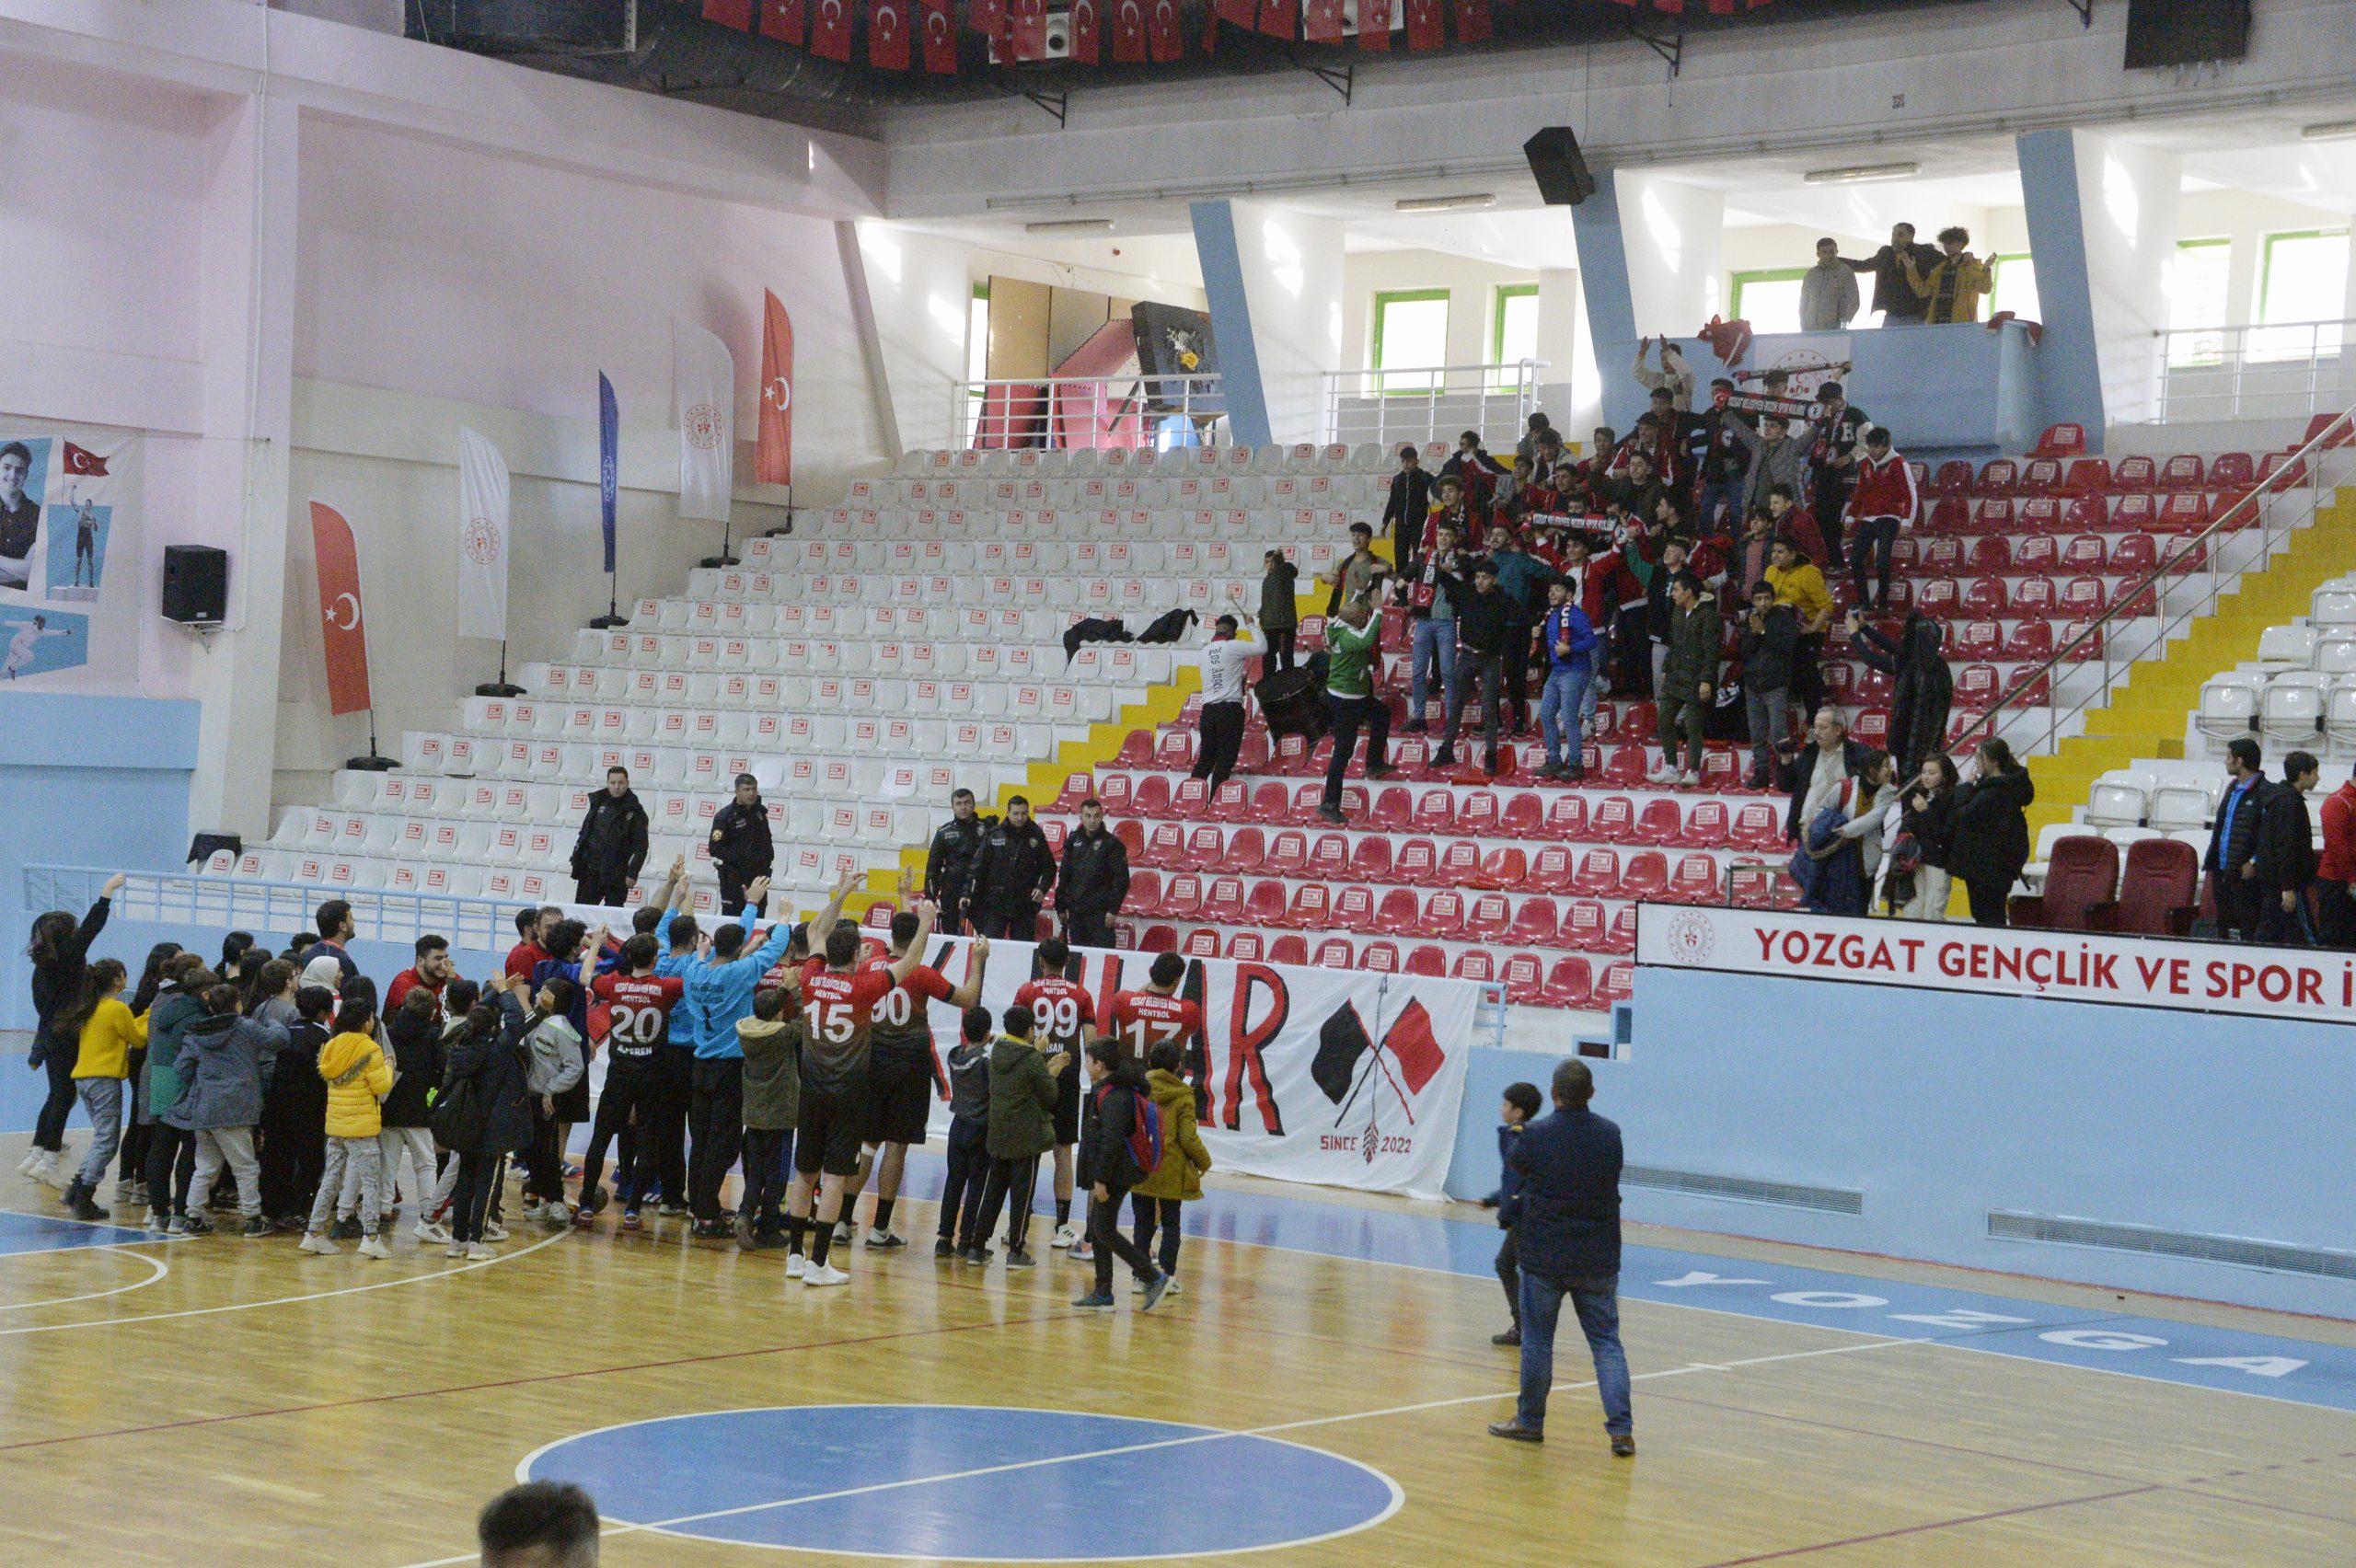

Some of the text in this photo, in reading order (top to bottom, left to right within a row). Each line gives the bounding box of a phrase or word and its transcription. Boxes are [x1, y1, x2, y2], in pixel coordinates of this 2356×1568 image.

[1754, 928, 1924, 975] YOZGAT
[1939, 942, 2118, 992] GENÇLİK
[2136, 957, 2189, 996] VE
[2208, 962, 2326, 1006] SPOR
[610, 1004, 663, 1043] 20
[803, 999, 855, 1043] 15
[1033, 997, 1078, 1038] 99
[1138, 1008, 1171, 1019] HENTBOL
[1320, 1135, 1413, 1154] SINCE 2022
